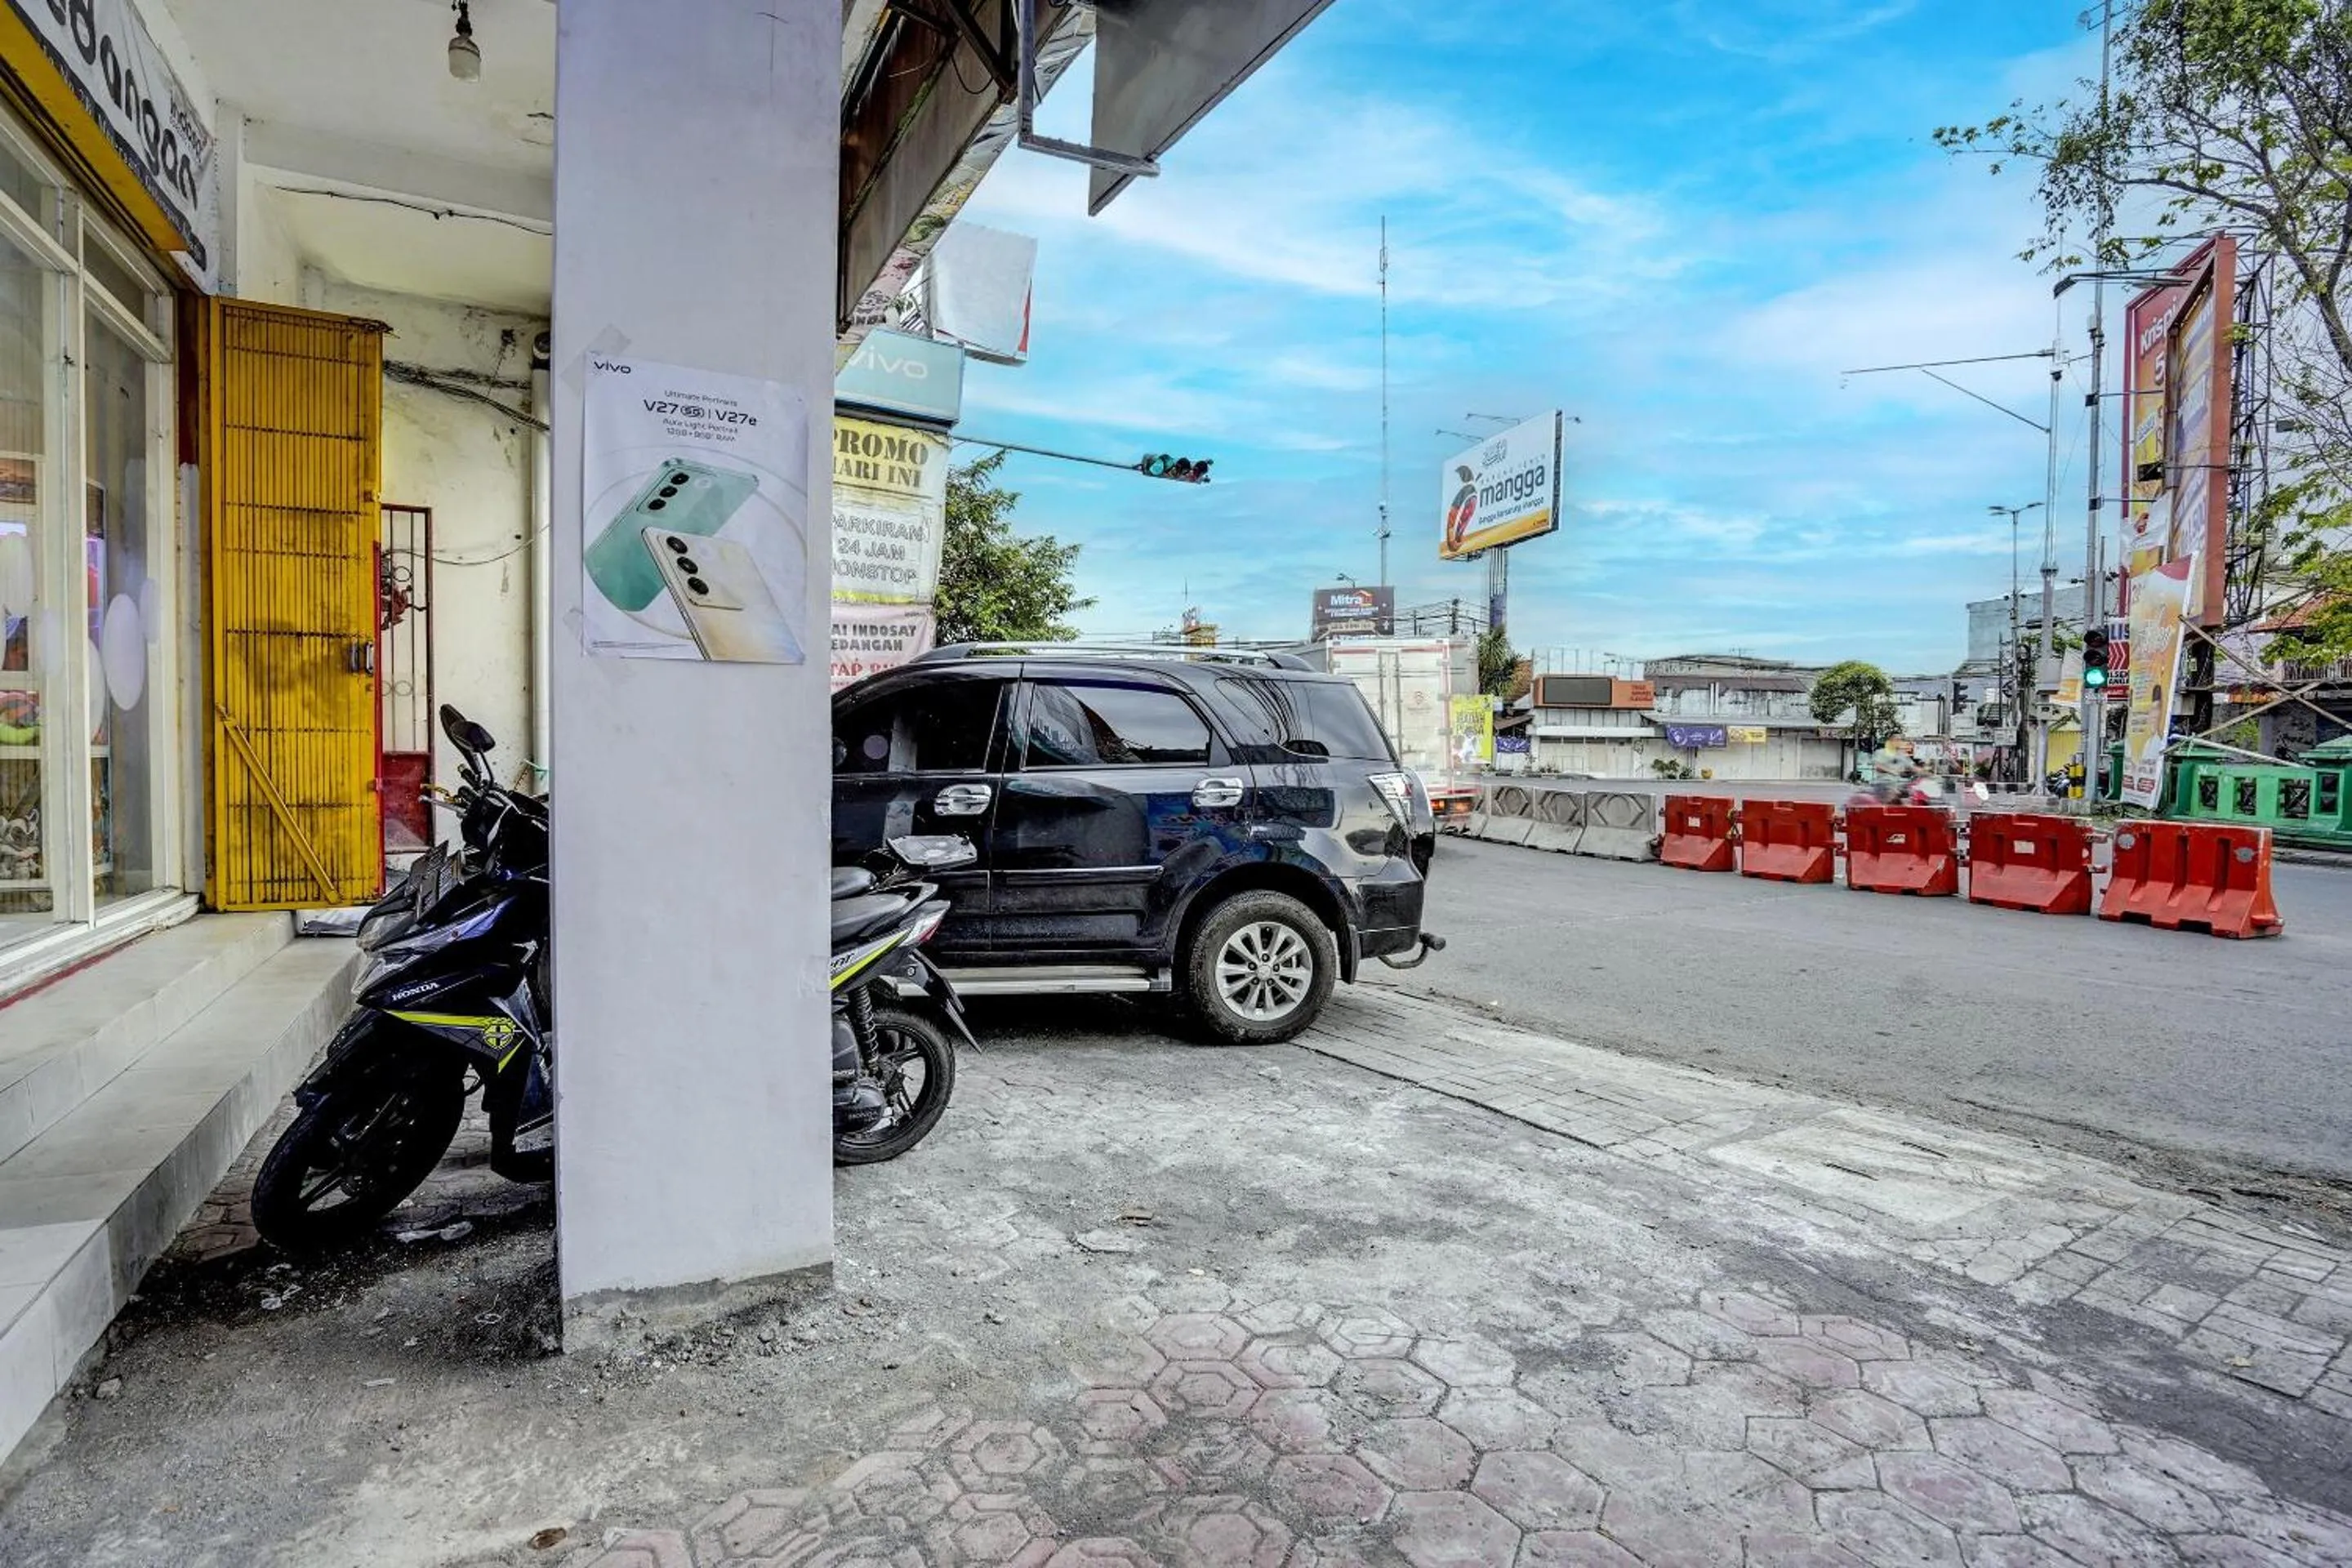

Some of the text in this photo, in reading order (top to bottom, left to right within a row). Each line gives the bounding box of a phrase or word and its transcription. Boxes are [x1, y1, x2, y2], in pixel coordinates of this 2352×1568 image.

[593, 360, 632, 375] vivo
[849, 345, 928, 379] vivo
[643, 399, 679, 414] V27
[715, 409, 756, 425] V27e
[834, 429, 929, 465] ROMO
[888, 465, 921, 488] INI
[1480, 465, 1545, 508] mangga
[838, 537, 861, 555] 24
[392, 982, 439, 1001] HONDA
